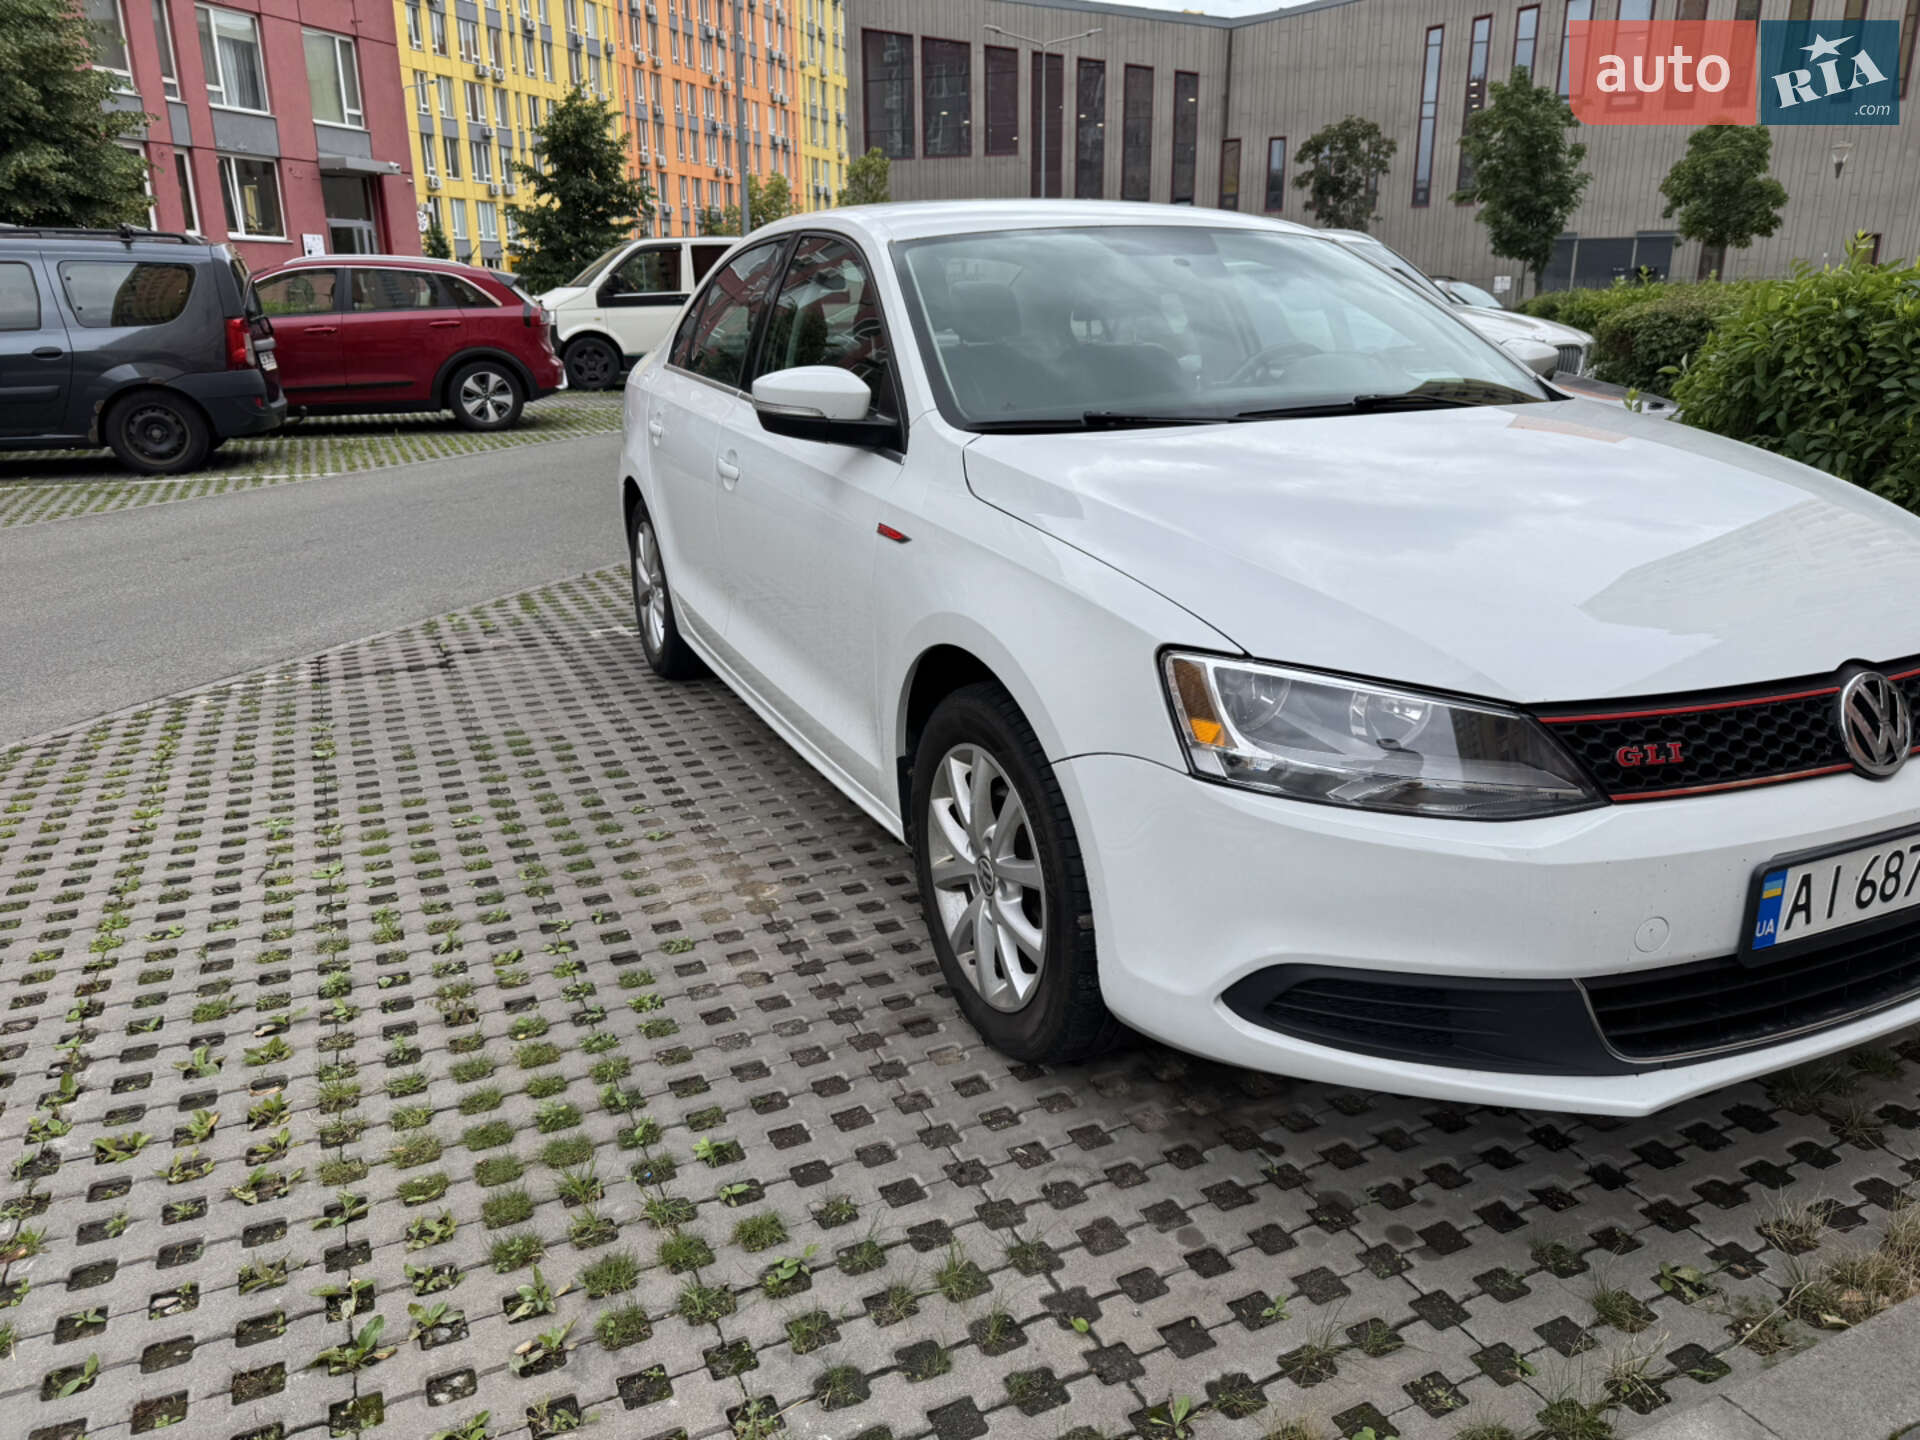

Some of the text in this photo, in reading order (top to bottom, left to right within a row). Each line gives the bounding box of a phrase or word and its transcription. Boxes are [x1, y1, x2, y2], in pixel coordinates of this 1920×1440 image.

[1843, 672, 1909, 776] VW
[1616, 741, 1685, 768] GLI
[1784, 865, 1842, 931] AI
[1755, 918, 1775, 938] UA
